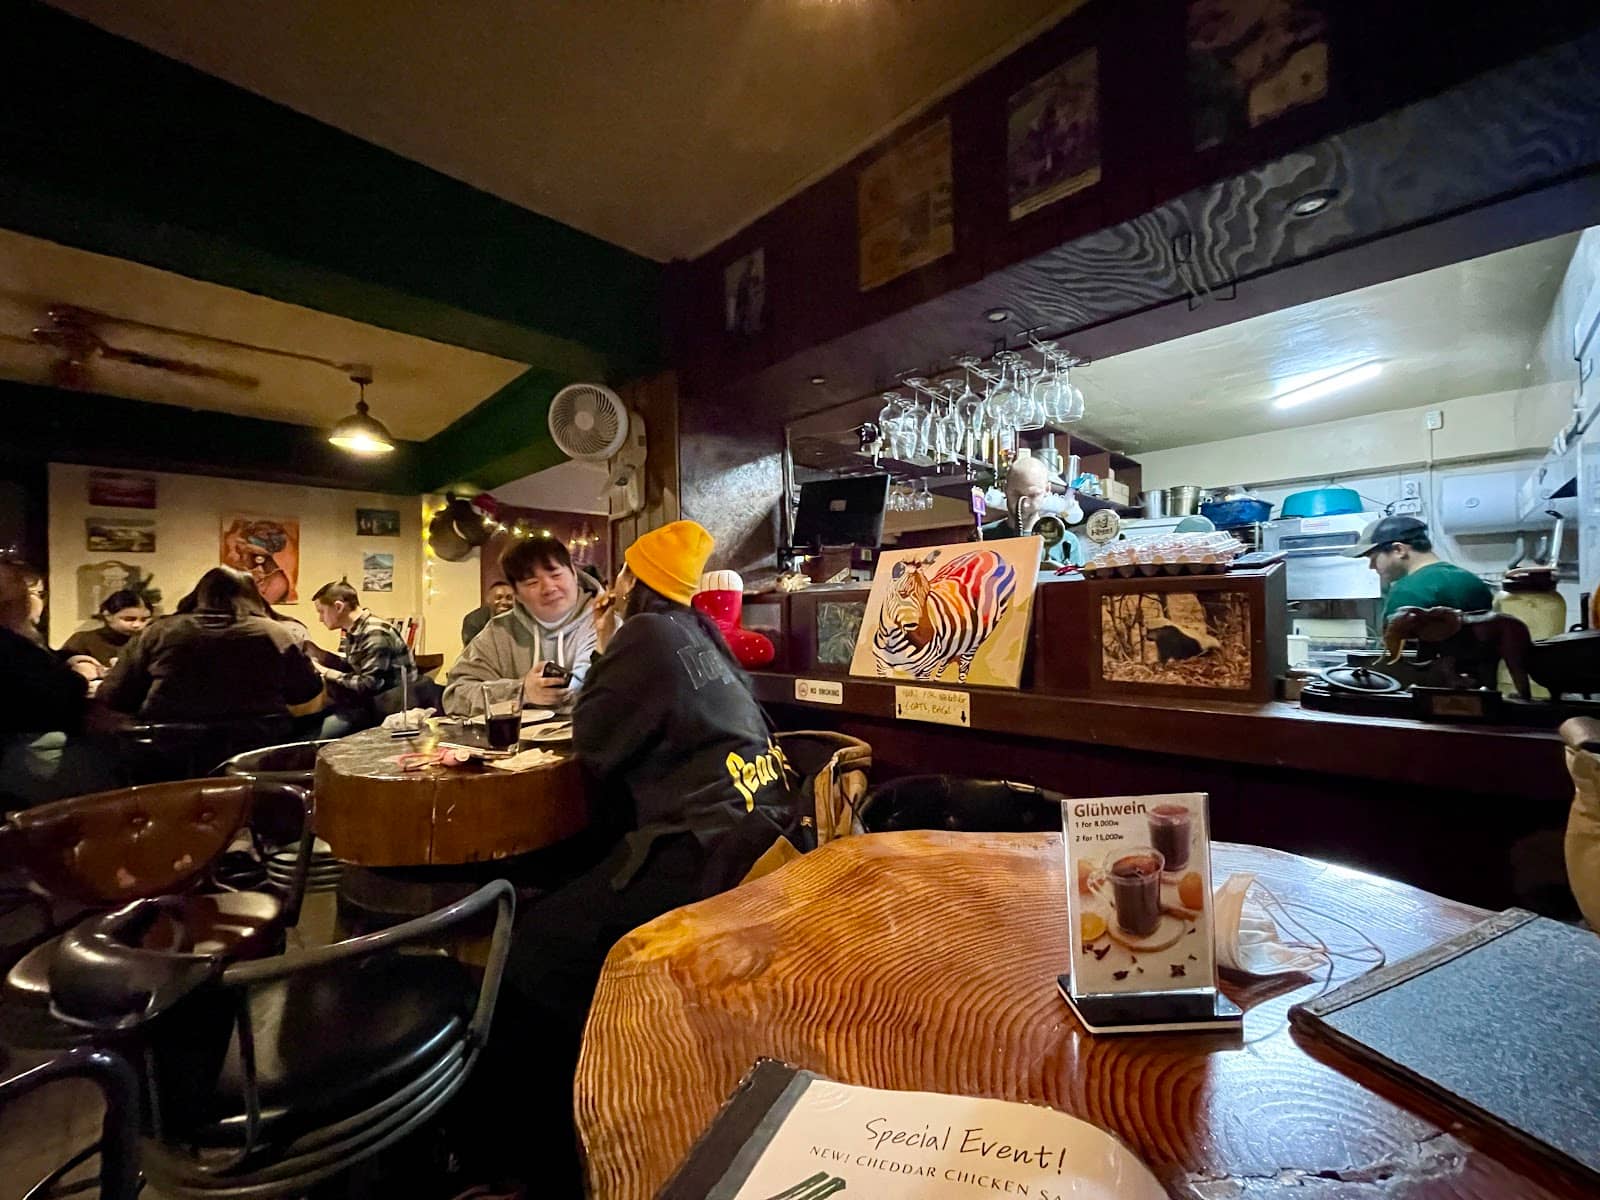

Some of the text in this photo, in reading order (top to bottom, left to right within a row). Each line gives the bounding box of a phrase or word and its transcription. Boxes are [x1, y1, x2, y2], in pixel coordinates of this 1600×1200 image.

[818, 688, 839, 696] SMOKING
[1074, 801, 1147, 818] Glühwein
[1082, 834, 1093, 842] for
[865, 1116, 1067, 1176] Special Event!
[808, 1145, 852, 1165] NEW!
[856, 1154, 938, 1178] CHEDDAR
[944, 1168, 1031, 1197] CHICKEN
